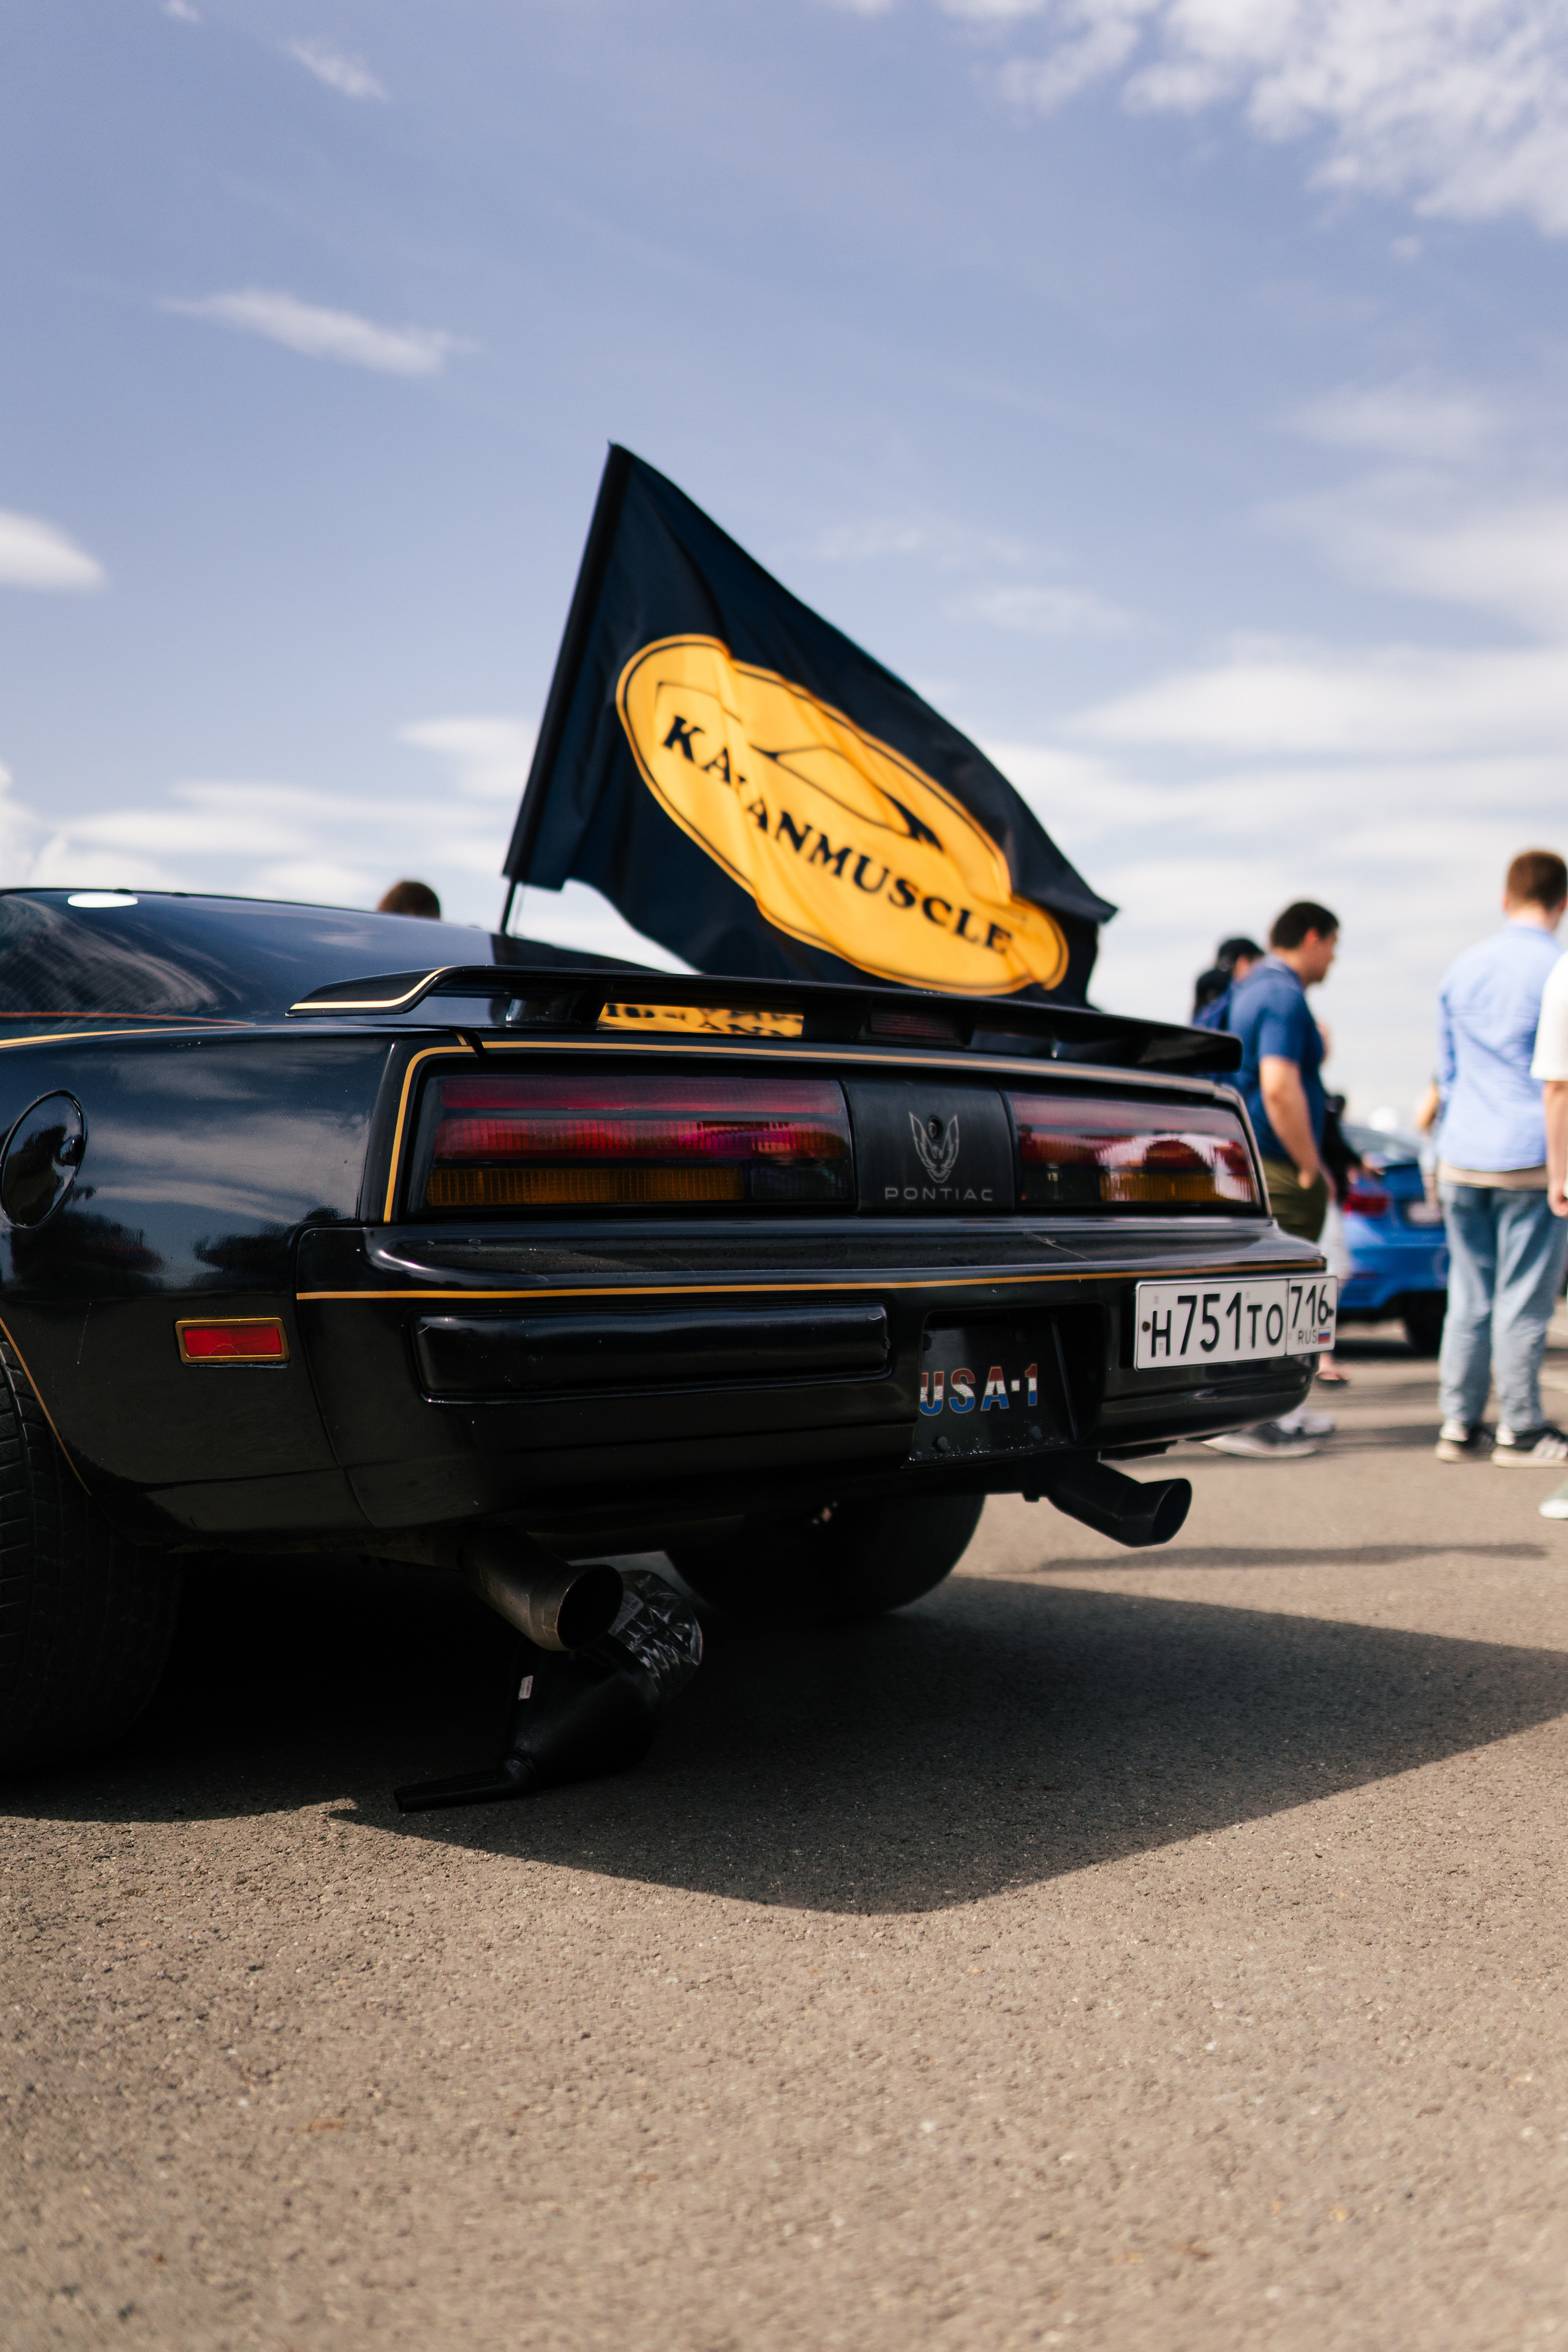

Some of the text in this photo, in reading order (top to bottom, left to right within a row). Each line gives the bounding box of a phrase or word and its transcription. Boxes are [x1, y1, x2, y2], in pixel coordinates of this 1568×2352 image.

[662, 715, 1015, 956] KAANMUSCLE
[884, 1187, 993, 1202] PONTIAC
[1291, 1284, 1329, 1330] 716
[1298, 1330, 1318, 1345] RUS
[919, 1363, 1038, 1416] USA-1
